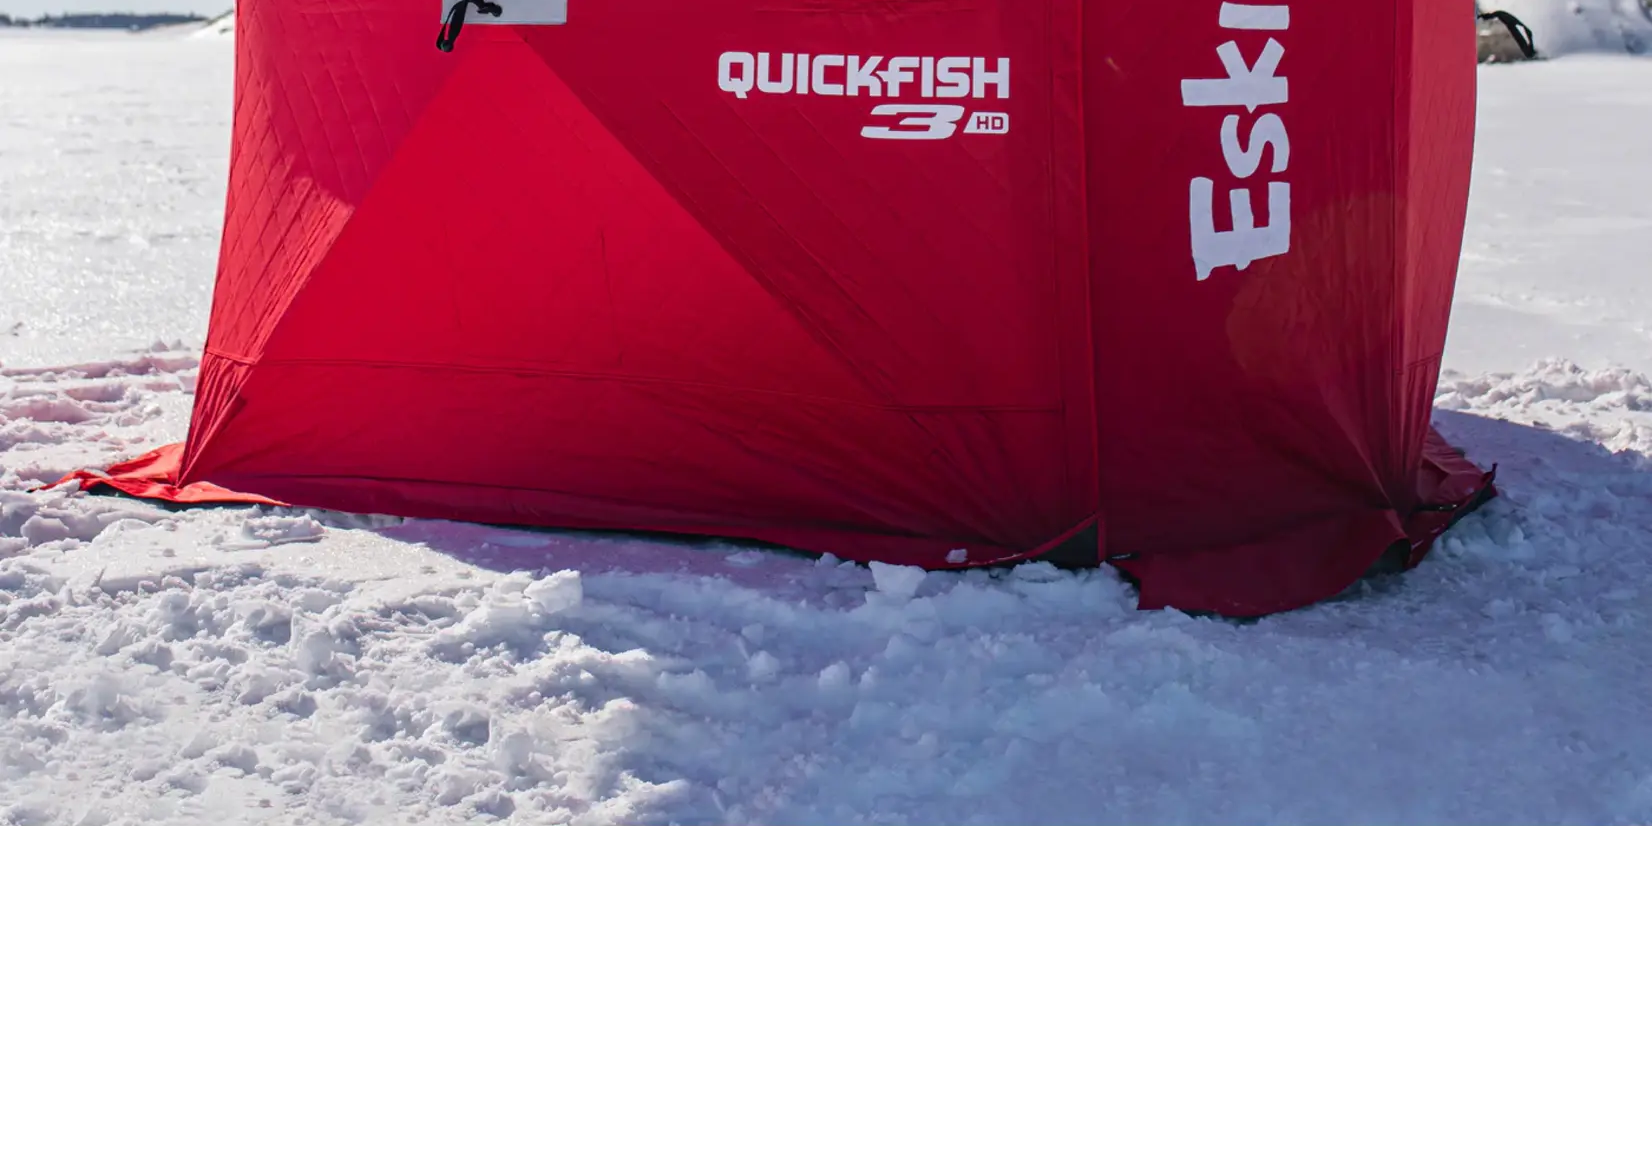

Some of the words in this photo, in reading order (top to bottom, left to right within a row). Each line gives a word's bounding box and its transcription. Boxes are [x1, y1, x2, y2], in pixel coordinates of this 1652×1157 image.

[717, 51, 1010, 99] QUICKFISH
[860, 103, 965, 140] 3
[975, 115, 1005, 131] HD
